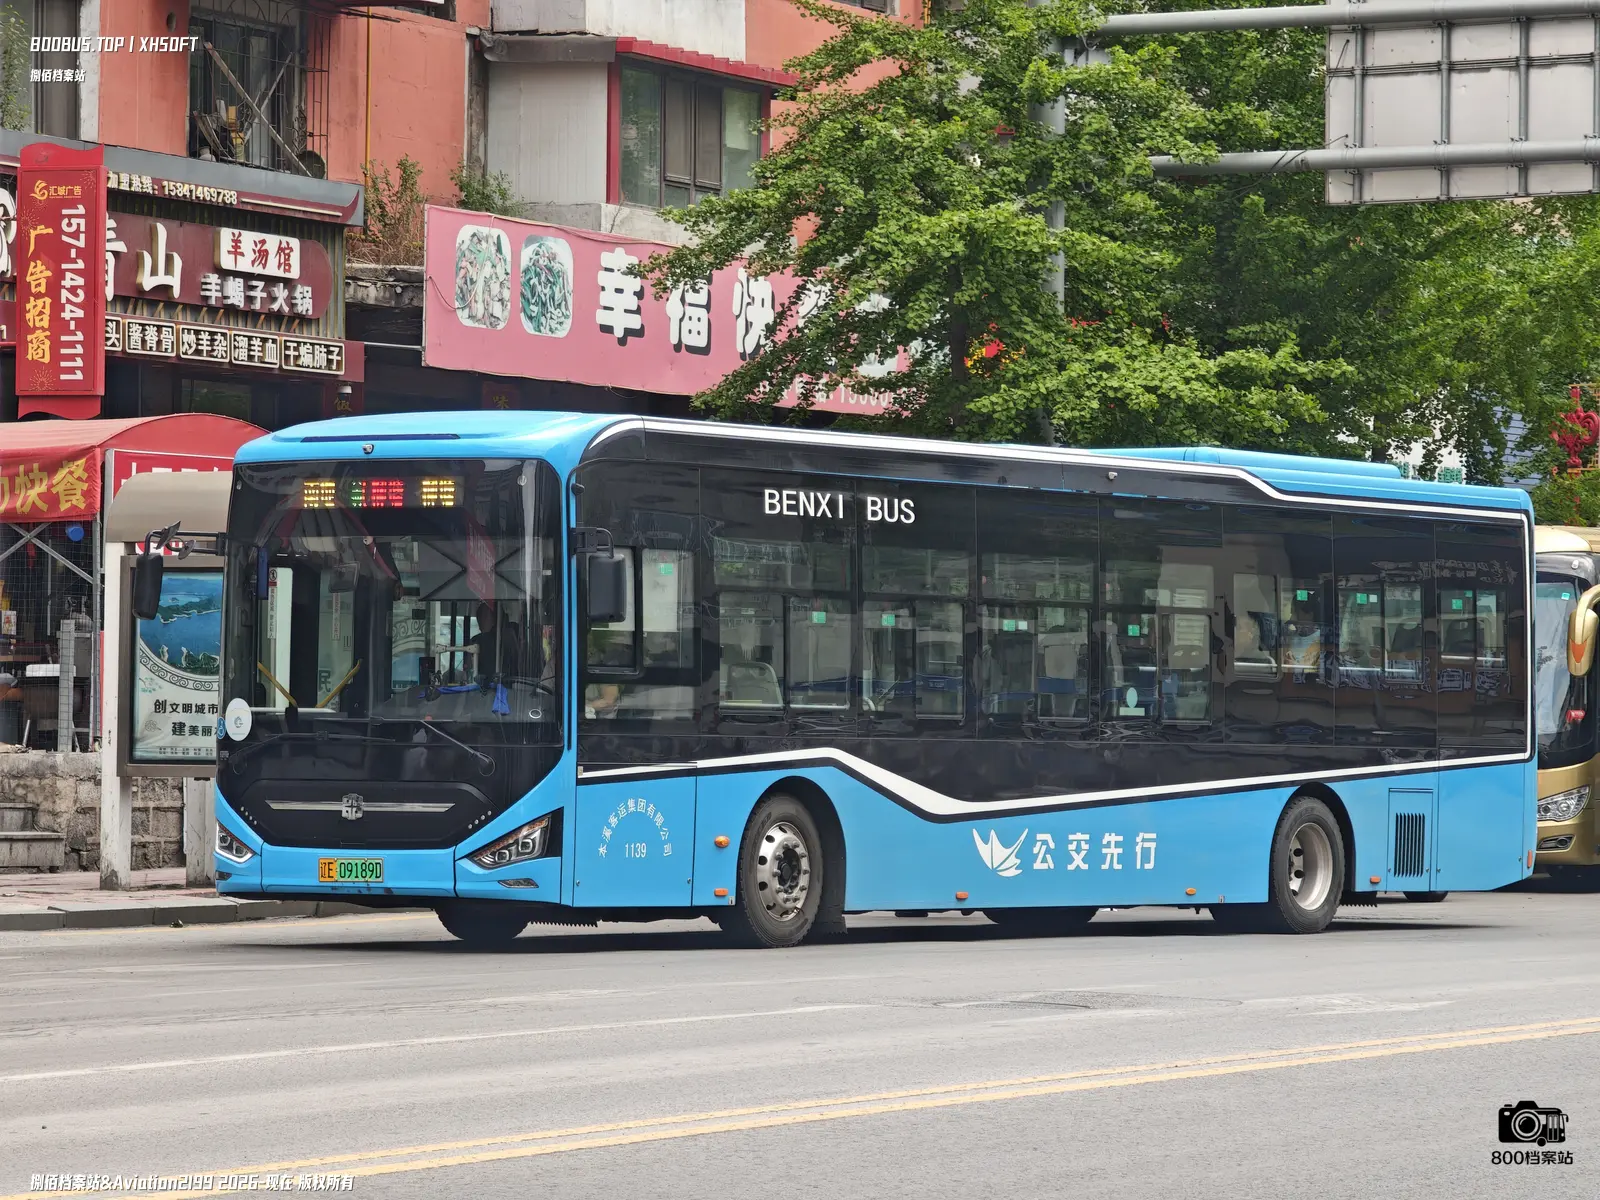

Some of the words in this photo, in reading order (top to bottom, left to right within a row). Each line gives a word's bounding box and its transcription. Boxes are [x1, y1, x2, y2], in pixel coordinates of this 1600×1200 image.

[49, 185, 82, 196] 汇城广告
[161, 180, 238, 205] 15841469788
[226, 231, 295, 274] 羊汤馆
[25, 224, 54, 364] 广告招商
[59, 204, 86, 380] 157-1424-1111
[200, 273, 313, 316] 羊蝎子火锅
[128, 323, 175, 354] 酱脊骨
[182, 329, 228, 359] 炒羊杂
[764, 488, 844, 519] BENXI
[867, 496, 916, 524] BUS
[154, 699, 219, 714] 创文明城市
[598, 797, 673, 858] 本溪客运集团有限公司
[625, 842, 647, 858] 1139
[1032, 832, 1157, 870] 公交先行
